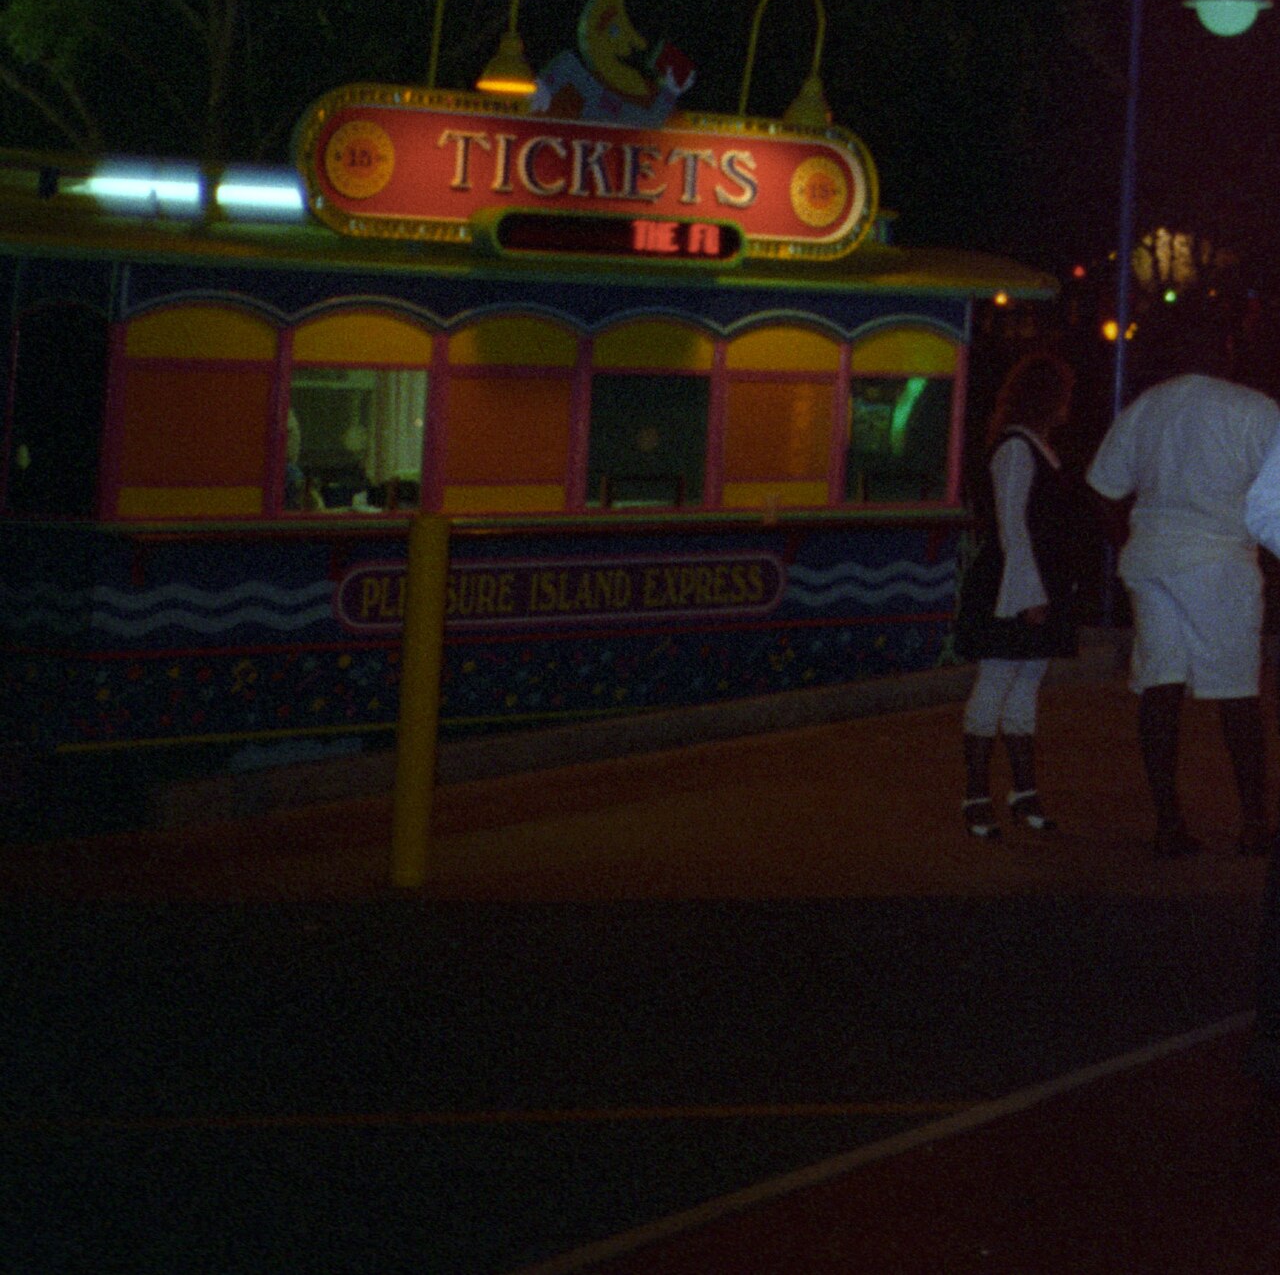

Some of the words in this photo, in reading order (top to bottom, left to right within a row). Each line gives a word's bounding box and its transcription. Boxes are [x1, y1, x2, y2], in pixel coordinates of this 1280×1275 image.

[438, 129, 759, 208] TICKETS
[360, 573, 515, 617] PLSURE
[529, 569, 632, 612] ISLAND
[642, 563, 766, 608] EXPRESS
